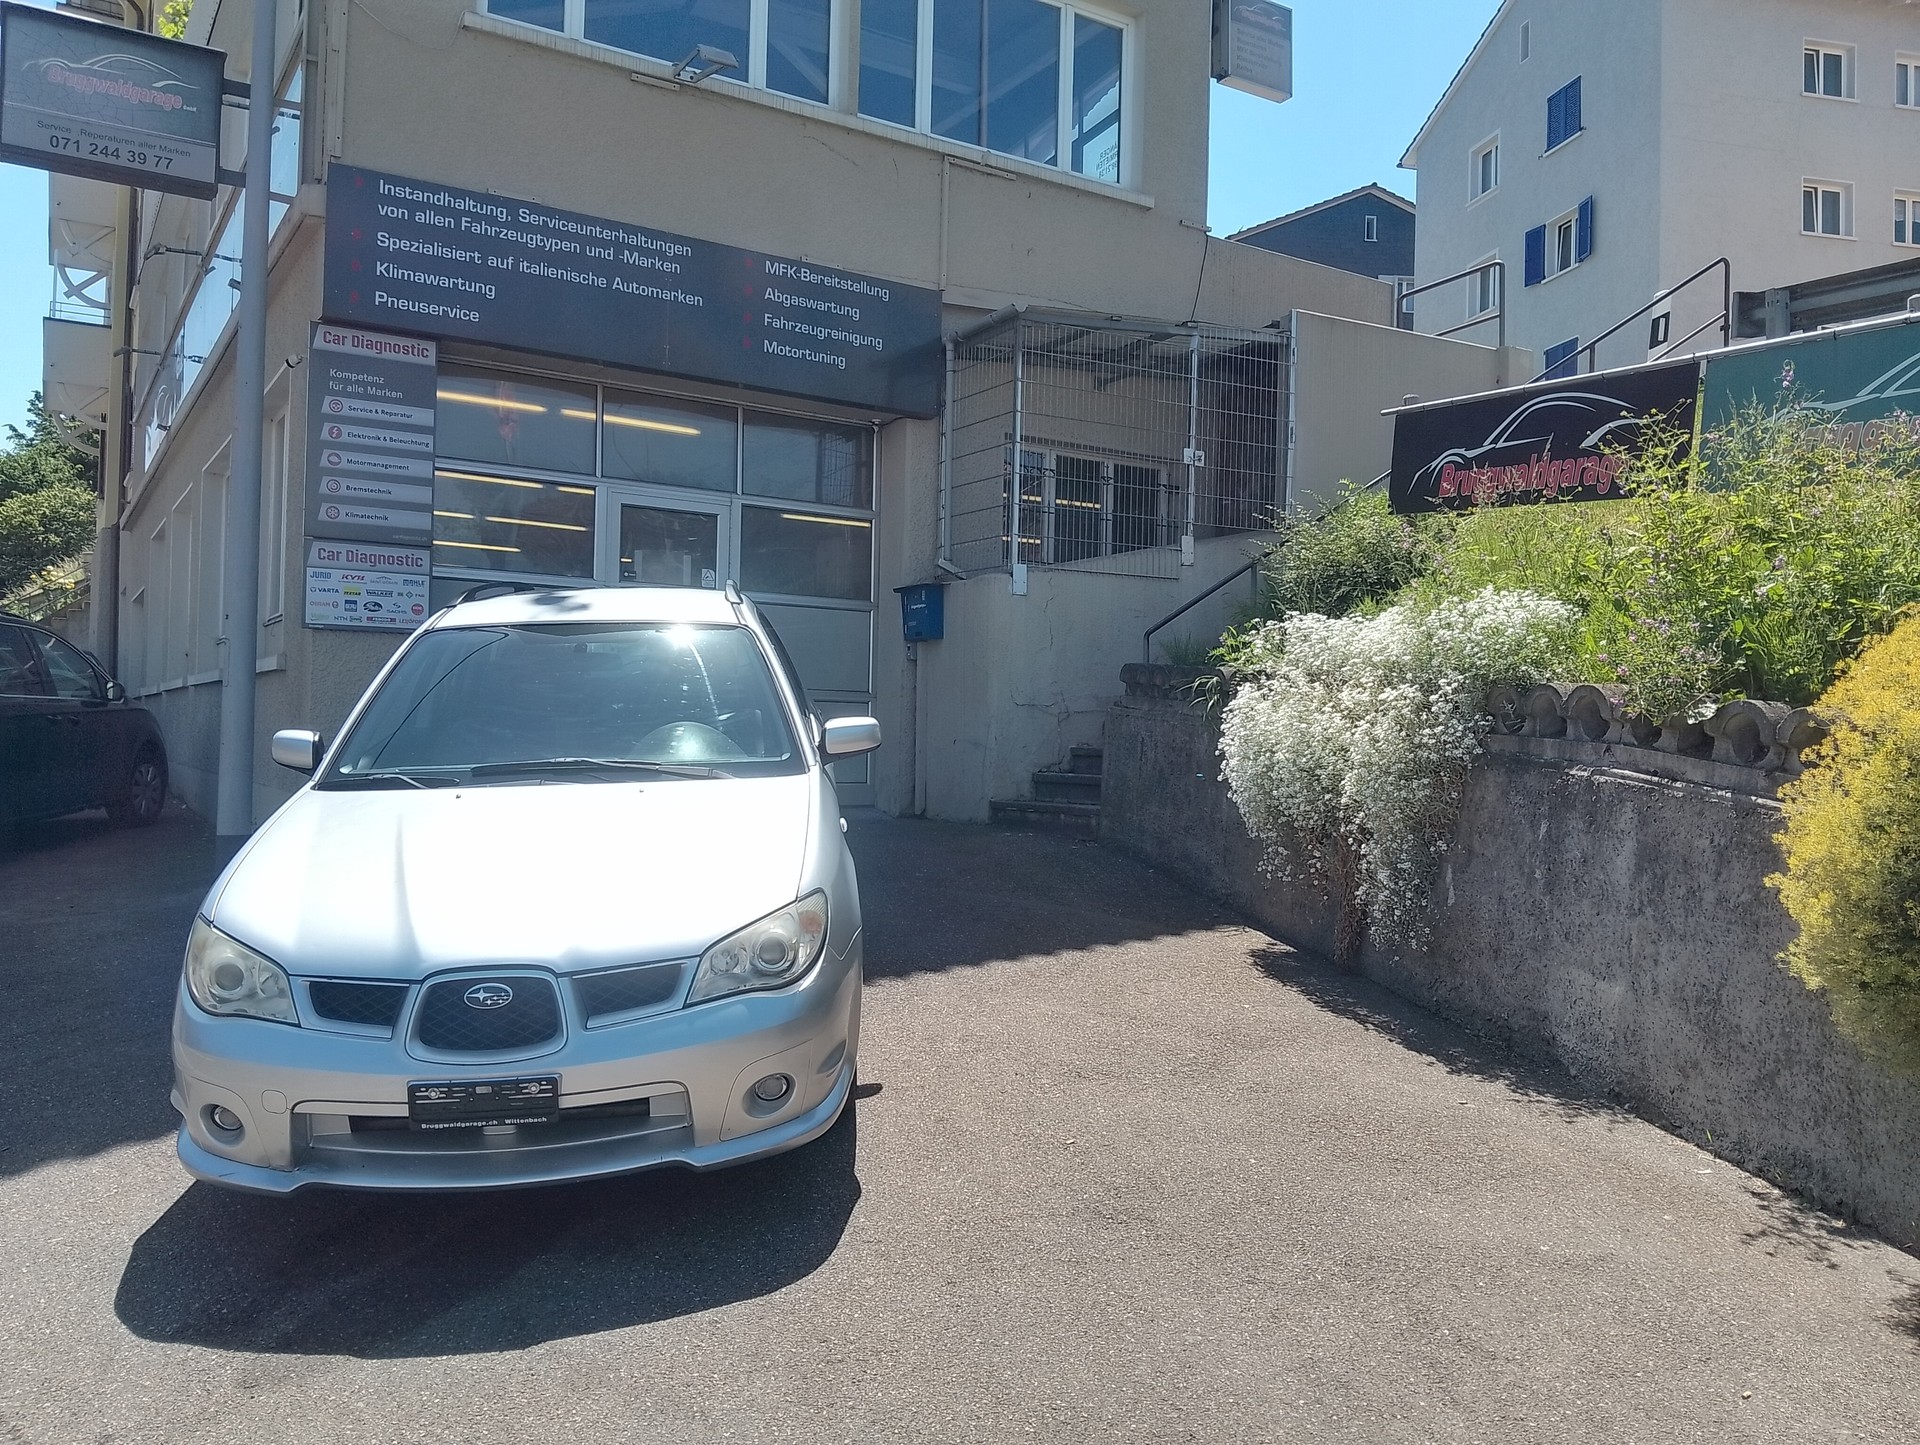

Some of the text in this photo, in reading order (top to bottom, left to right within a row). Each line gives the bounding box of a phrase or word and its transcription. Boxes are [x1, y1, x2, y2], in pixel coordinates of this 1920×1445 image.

[48, 65, 183, 111] Bruggwaldgarage
[37, 121, 72, 134] Service
[138, 140, 157, 151] aller
[159, 144, 191, 158] Marken
[50, 135, 174, 170] 071 244 39 77
[379, 179, 692, 257] Instandhaltung, Serviceunterhaltungen
[378, 203, 681, 275] von allen Fahrzeugtypen und -Marken
[376, 261, 496, 299] Klimawartung
[377, 232, 704, 307] Spezialisiert auf italienische Automarken
[765, 260, 890, 302] MFK-Bereitstellung
[375, 291, 480, 322] Pneuservice
[764, 287, 860, 321] Abgaswartung
[323, 330, 429, 358] Car Diagnostic
[764, 313, 883, 351] Fahrzeugreinigung
[763, 339, 846, 370] Motortuning
[329, 368, 385, 384] Kompetenz
[329, 381, 403, 399] für alle Marken
[348, 405, 373, 414] Service
[381, 409, 413, 419] Reparatur
[347, 431, 382, 442] Elektronik
[389, 437, 430, 449] Beleuchtung
[346, 458, 410, 471] Motormanagement
[345, 485, 392, 496] Bremstechnik
[345, 511, 389, 522] Klimatechnik
[317, 547, 423, 568] Car Diagnostic
[310, 571, 332, 580] JURID
[421, 1116, 548, 1129] Bruggwaldgarage.ch Wittenbach
